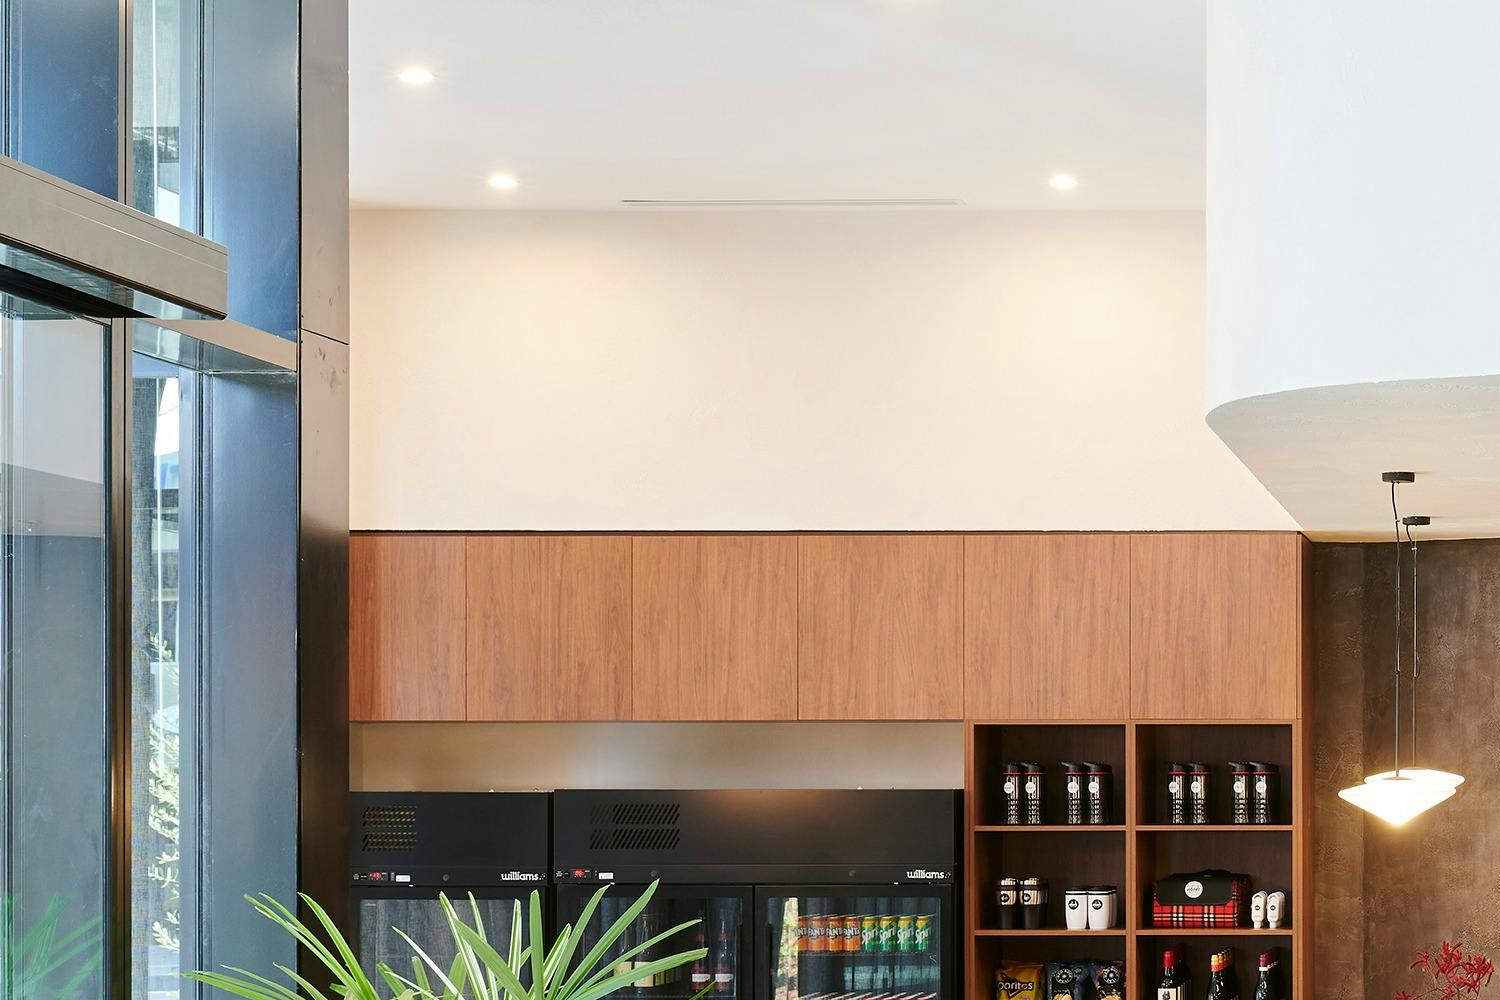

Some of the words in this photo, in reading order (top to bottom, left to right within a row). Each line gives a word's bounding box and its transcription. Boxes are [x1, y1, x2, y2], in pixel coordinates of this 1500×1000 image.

[501, 871, 539, 881] williams
[906, 869, 945, 879] williams
[998, 981, 1033, 991] Doritos
